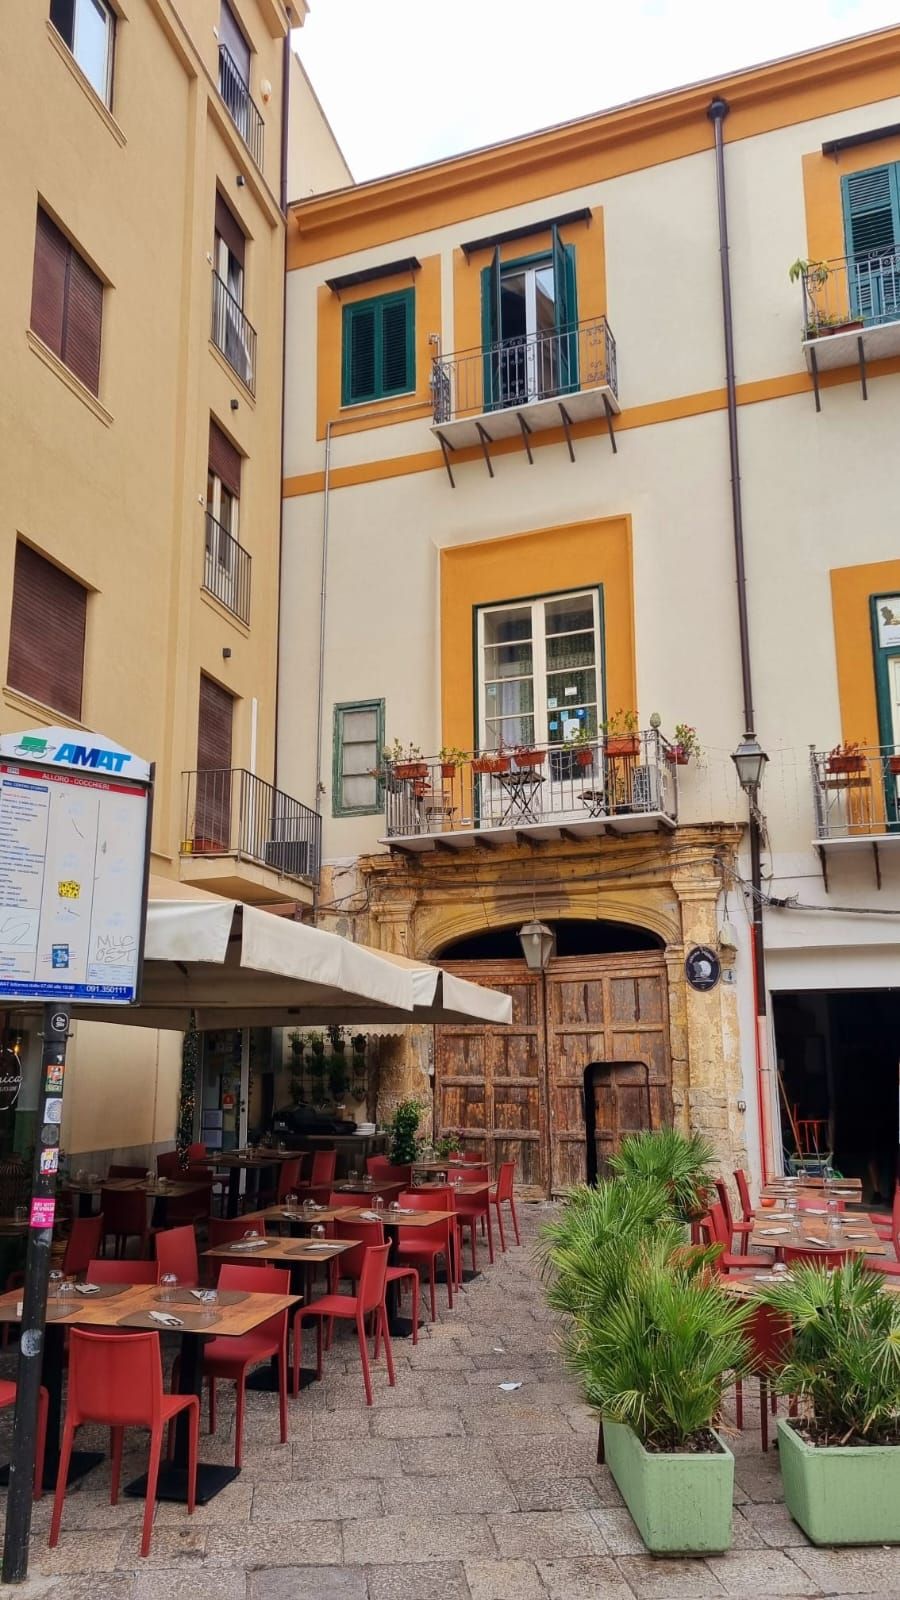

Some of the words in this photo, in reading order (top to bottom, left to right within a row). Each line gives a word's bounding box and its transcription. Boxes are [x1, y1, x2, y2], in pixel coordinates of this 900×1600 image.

[53, 743, 132, 772] AMAT
[41, 773, 70, 784] ALLORO
[73, 778, 110, 790] COCCHIERI
